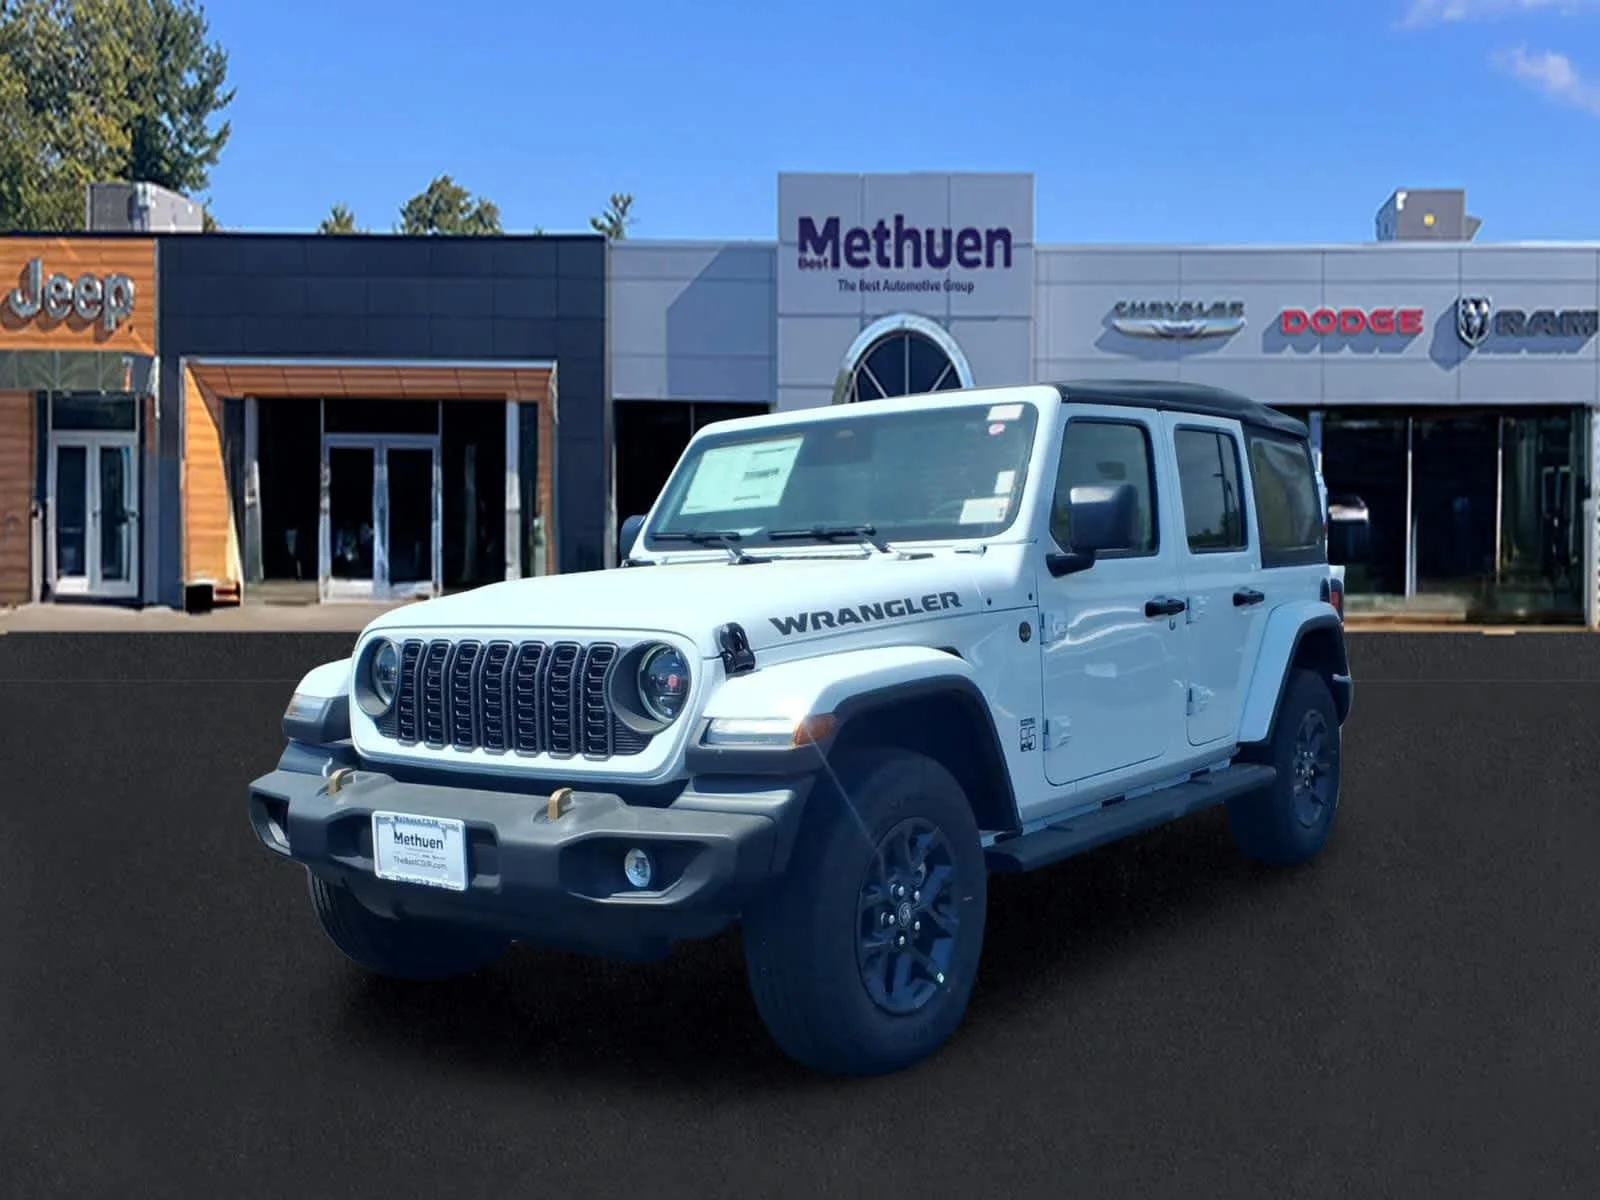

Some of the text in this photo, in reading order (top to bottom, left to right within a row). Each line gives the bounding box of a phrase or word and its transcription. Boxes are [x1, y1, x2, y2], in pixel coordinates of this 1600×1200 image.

[798, 214, 1012, 269] Methuen
[798, 258, 829, 270] Best
[8, 257, 135, 332] Jeep
[838, 279, 975, 294] The Best Automotive Group
[1114, 301, 1245, 318] CHRYSLER
[1281, 307, 1425, 336] DODGE
[1495, 310, 1599, 337] RAM
[768, 591, 964, 636] WRANGLER
[393, 831, 444, 850] Methuen
